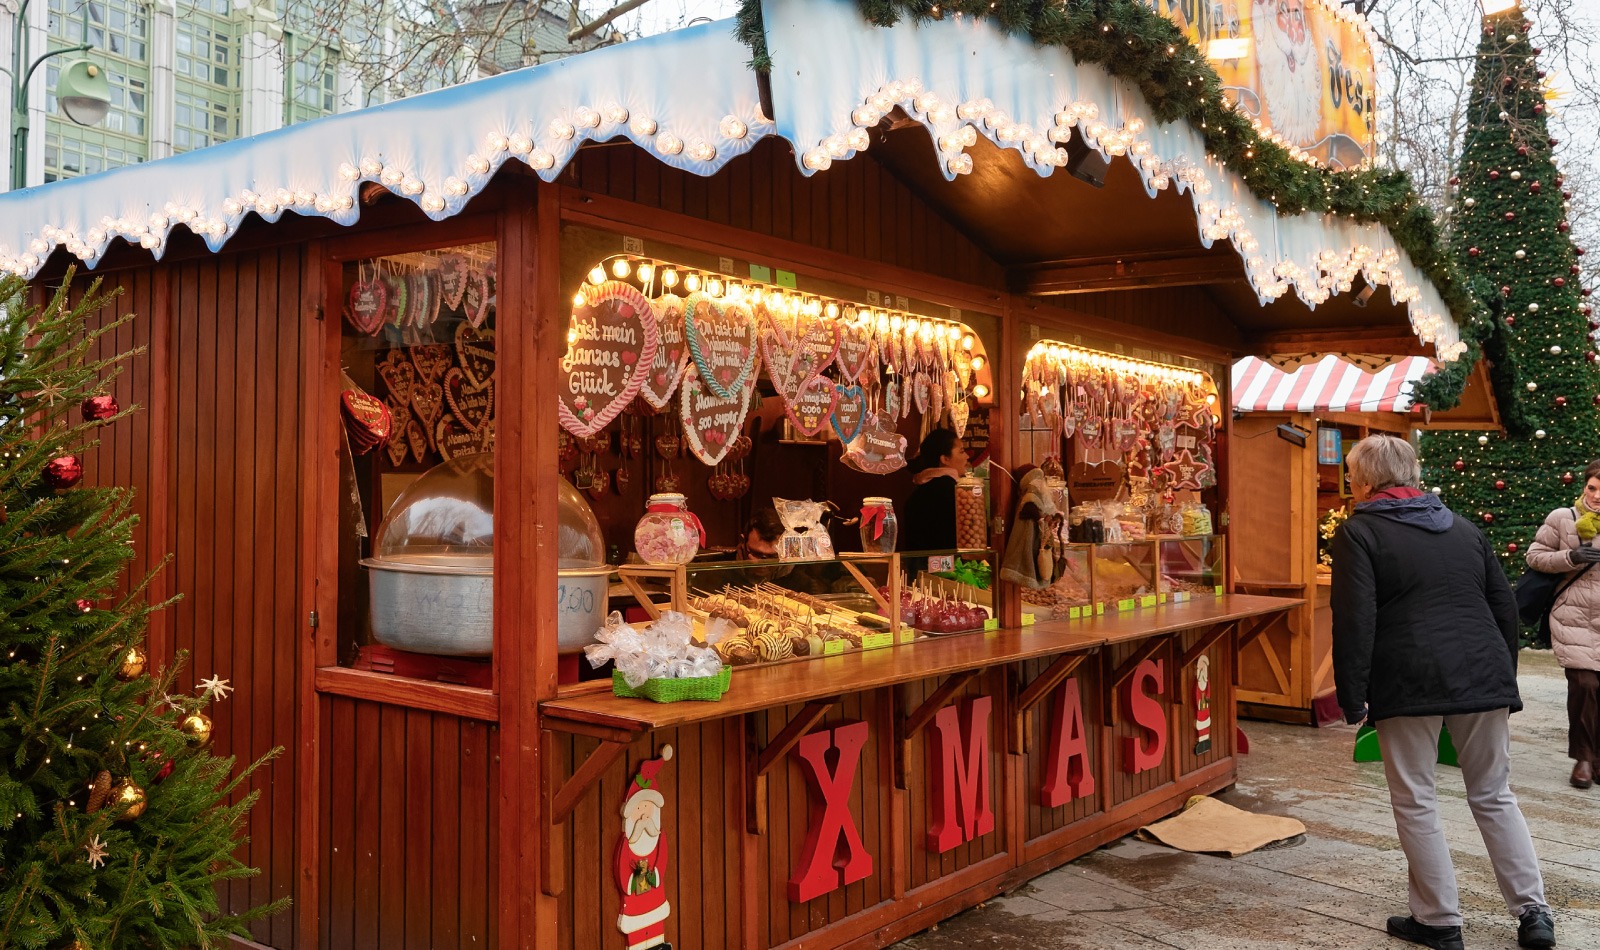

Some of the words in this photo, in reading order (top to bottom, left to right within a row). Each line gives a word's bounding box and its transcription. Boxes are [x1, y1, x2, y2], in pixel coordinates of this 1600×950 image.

[602, 321, 637, 346] mein
[712, 317, 732, 337] bist
[568, 368, 617, 396] Glück
[698, 415, 713, 431] soo
[713, 410, 739, 433] super
[788, 658, 1168, 904] XMAS
